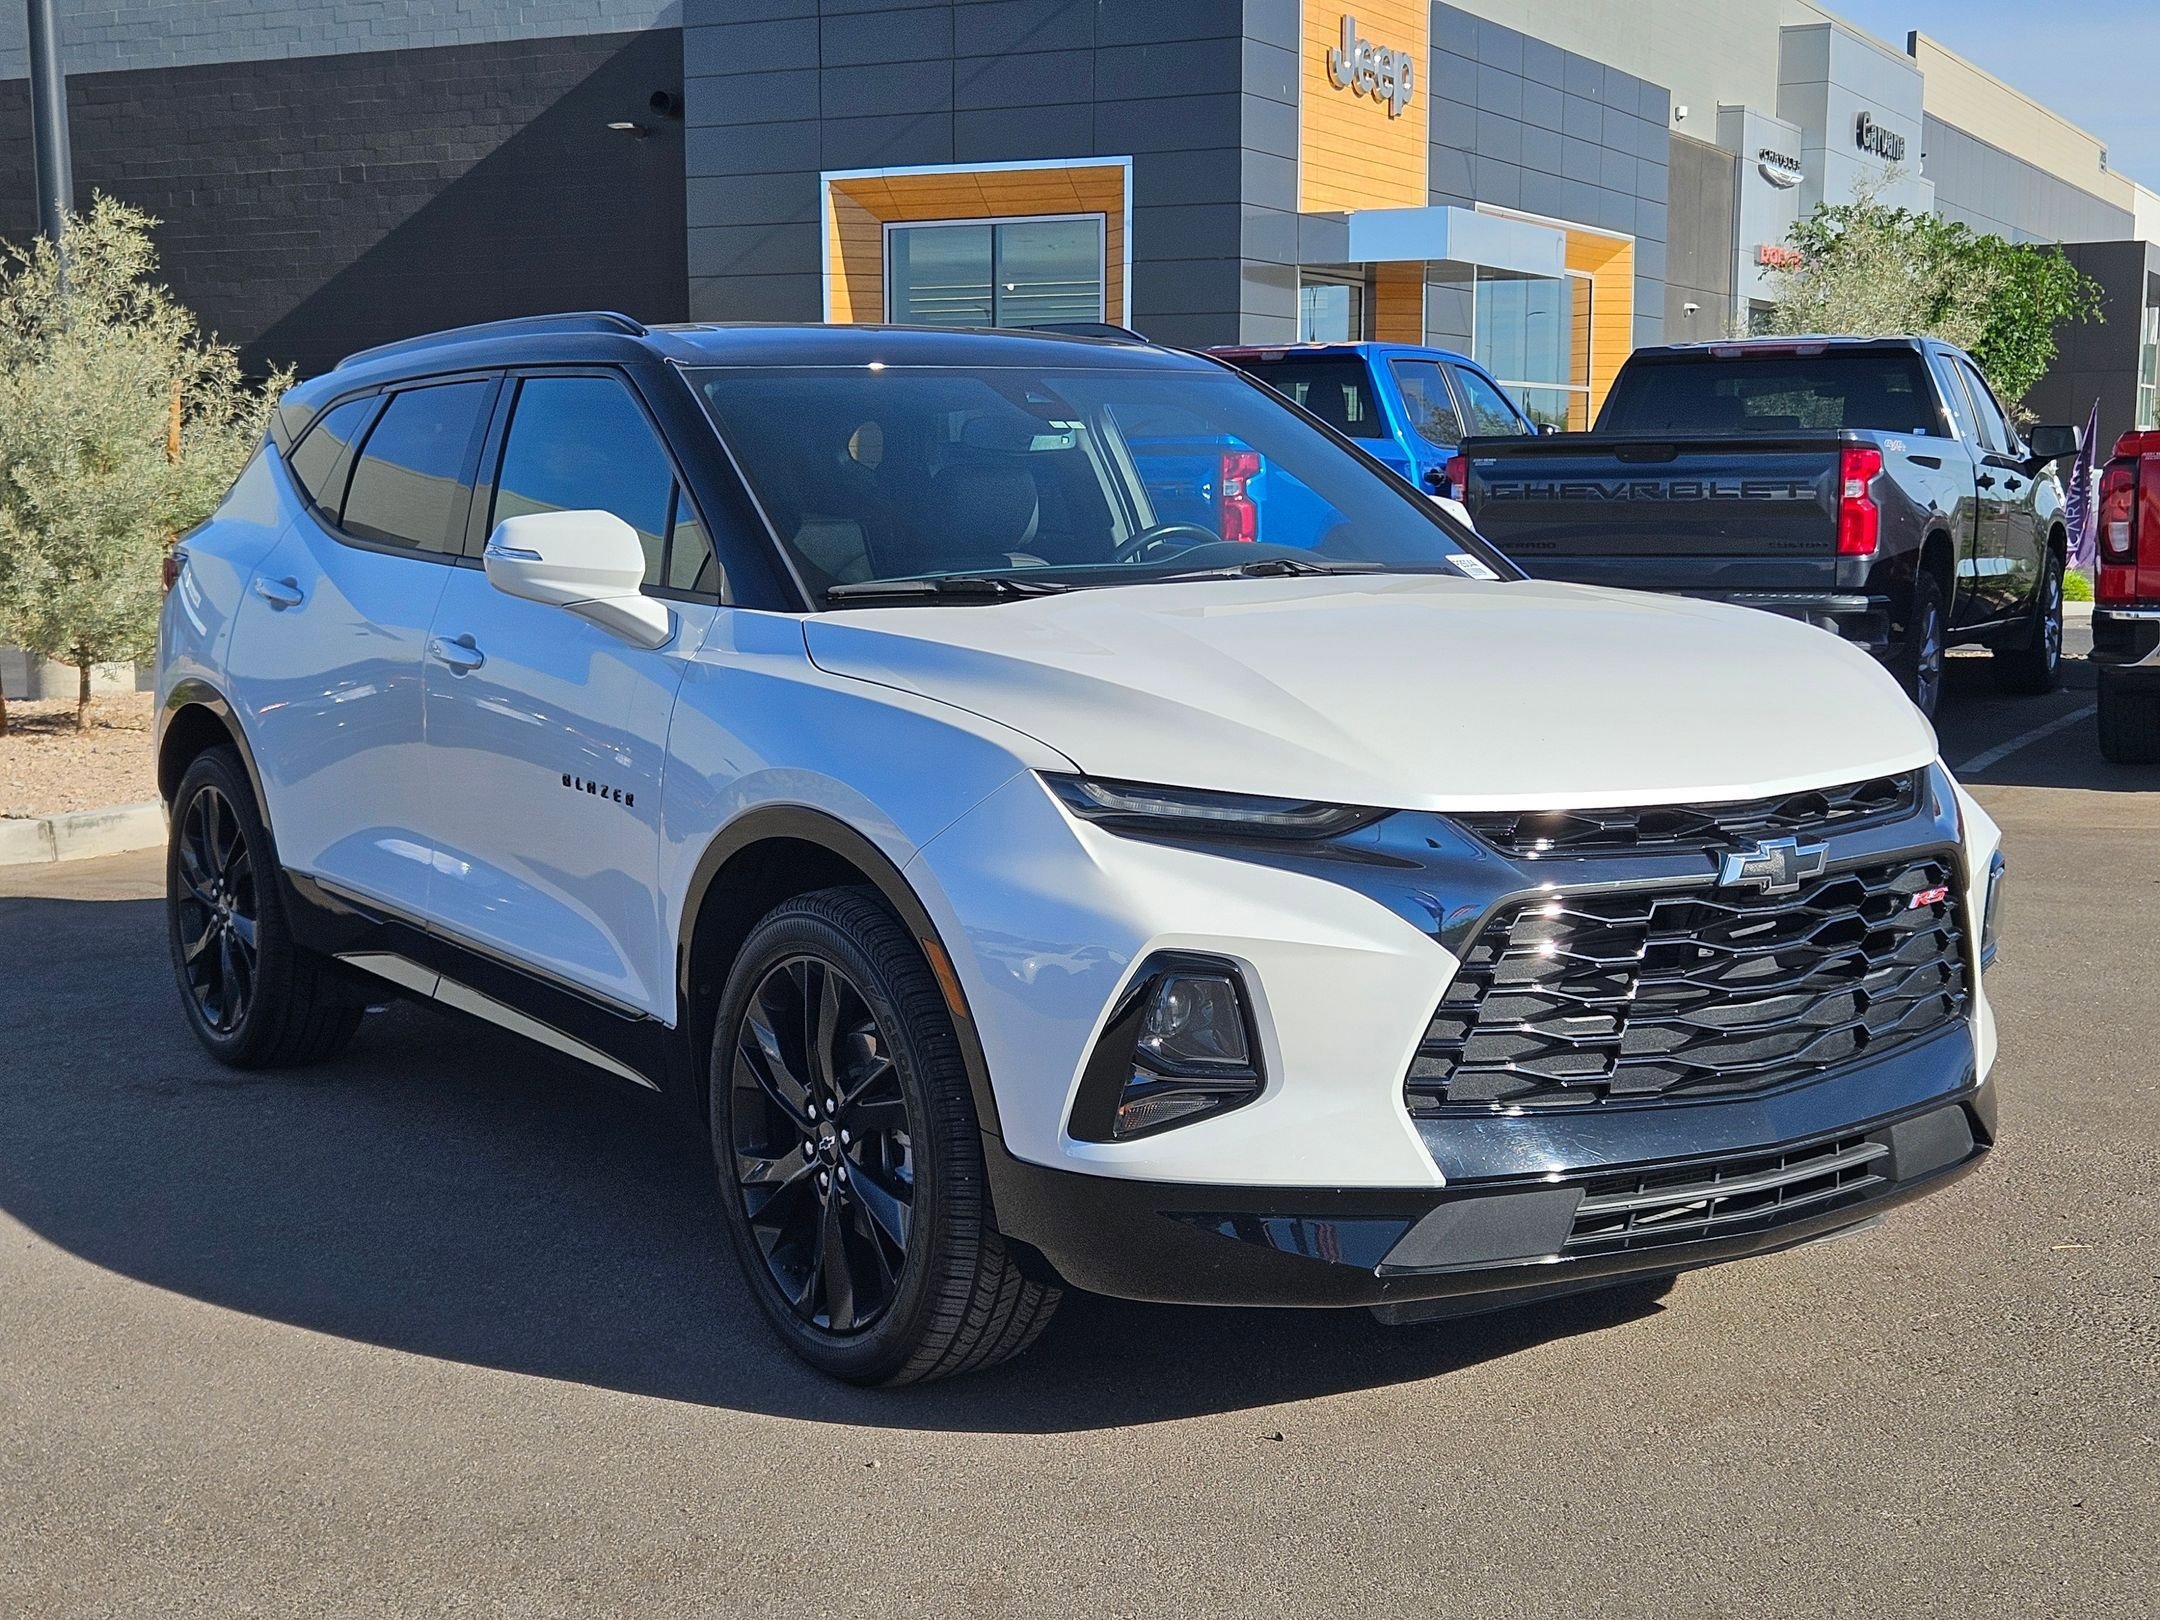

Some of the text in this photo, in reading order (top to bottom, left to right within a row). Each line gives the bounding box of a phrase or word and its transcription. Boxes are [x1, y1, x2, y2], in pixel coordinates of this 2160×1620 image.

[1329, 14, 1413, 118] Jeep
[1857, 111, 1905, 161] Carvana
[1490, 480, 1812, 501] CHEVROLET
[562, 773, 635, 808] BLAZER
[1908, 886, 1949, 909] RS
